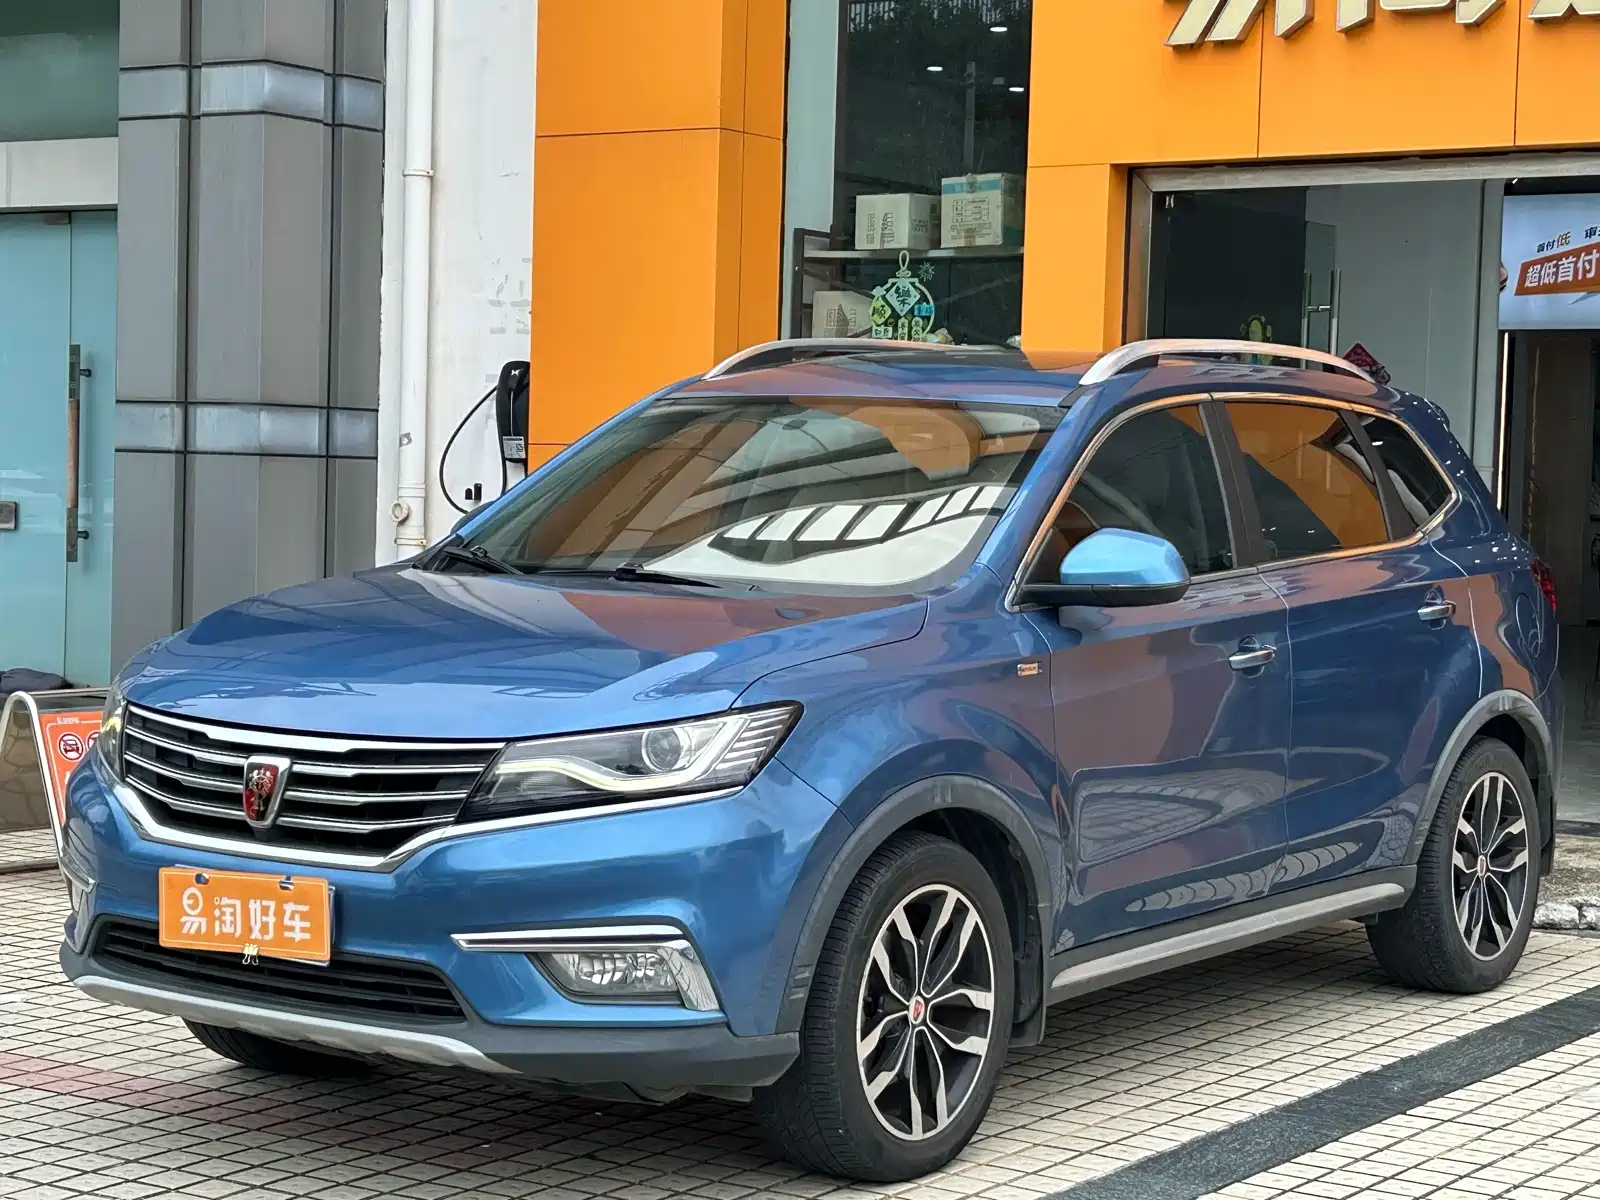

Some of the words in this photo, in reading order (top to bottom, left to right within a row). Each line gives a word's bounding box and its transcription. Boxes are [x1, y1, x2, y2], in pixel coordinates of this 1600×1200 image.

[1524, 248, 1600, 288] 超低首付
[179, 886, 312, 943] 易淘好车
